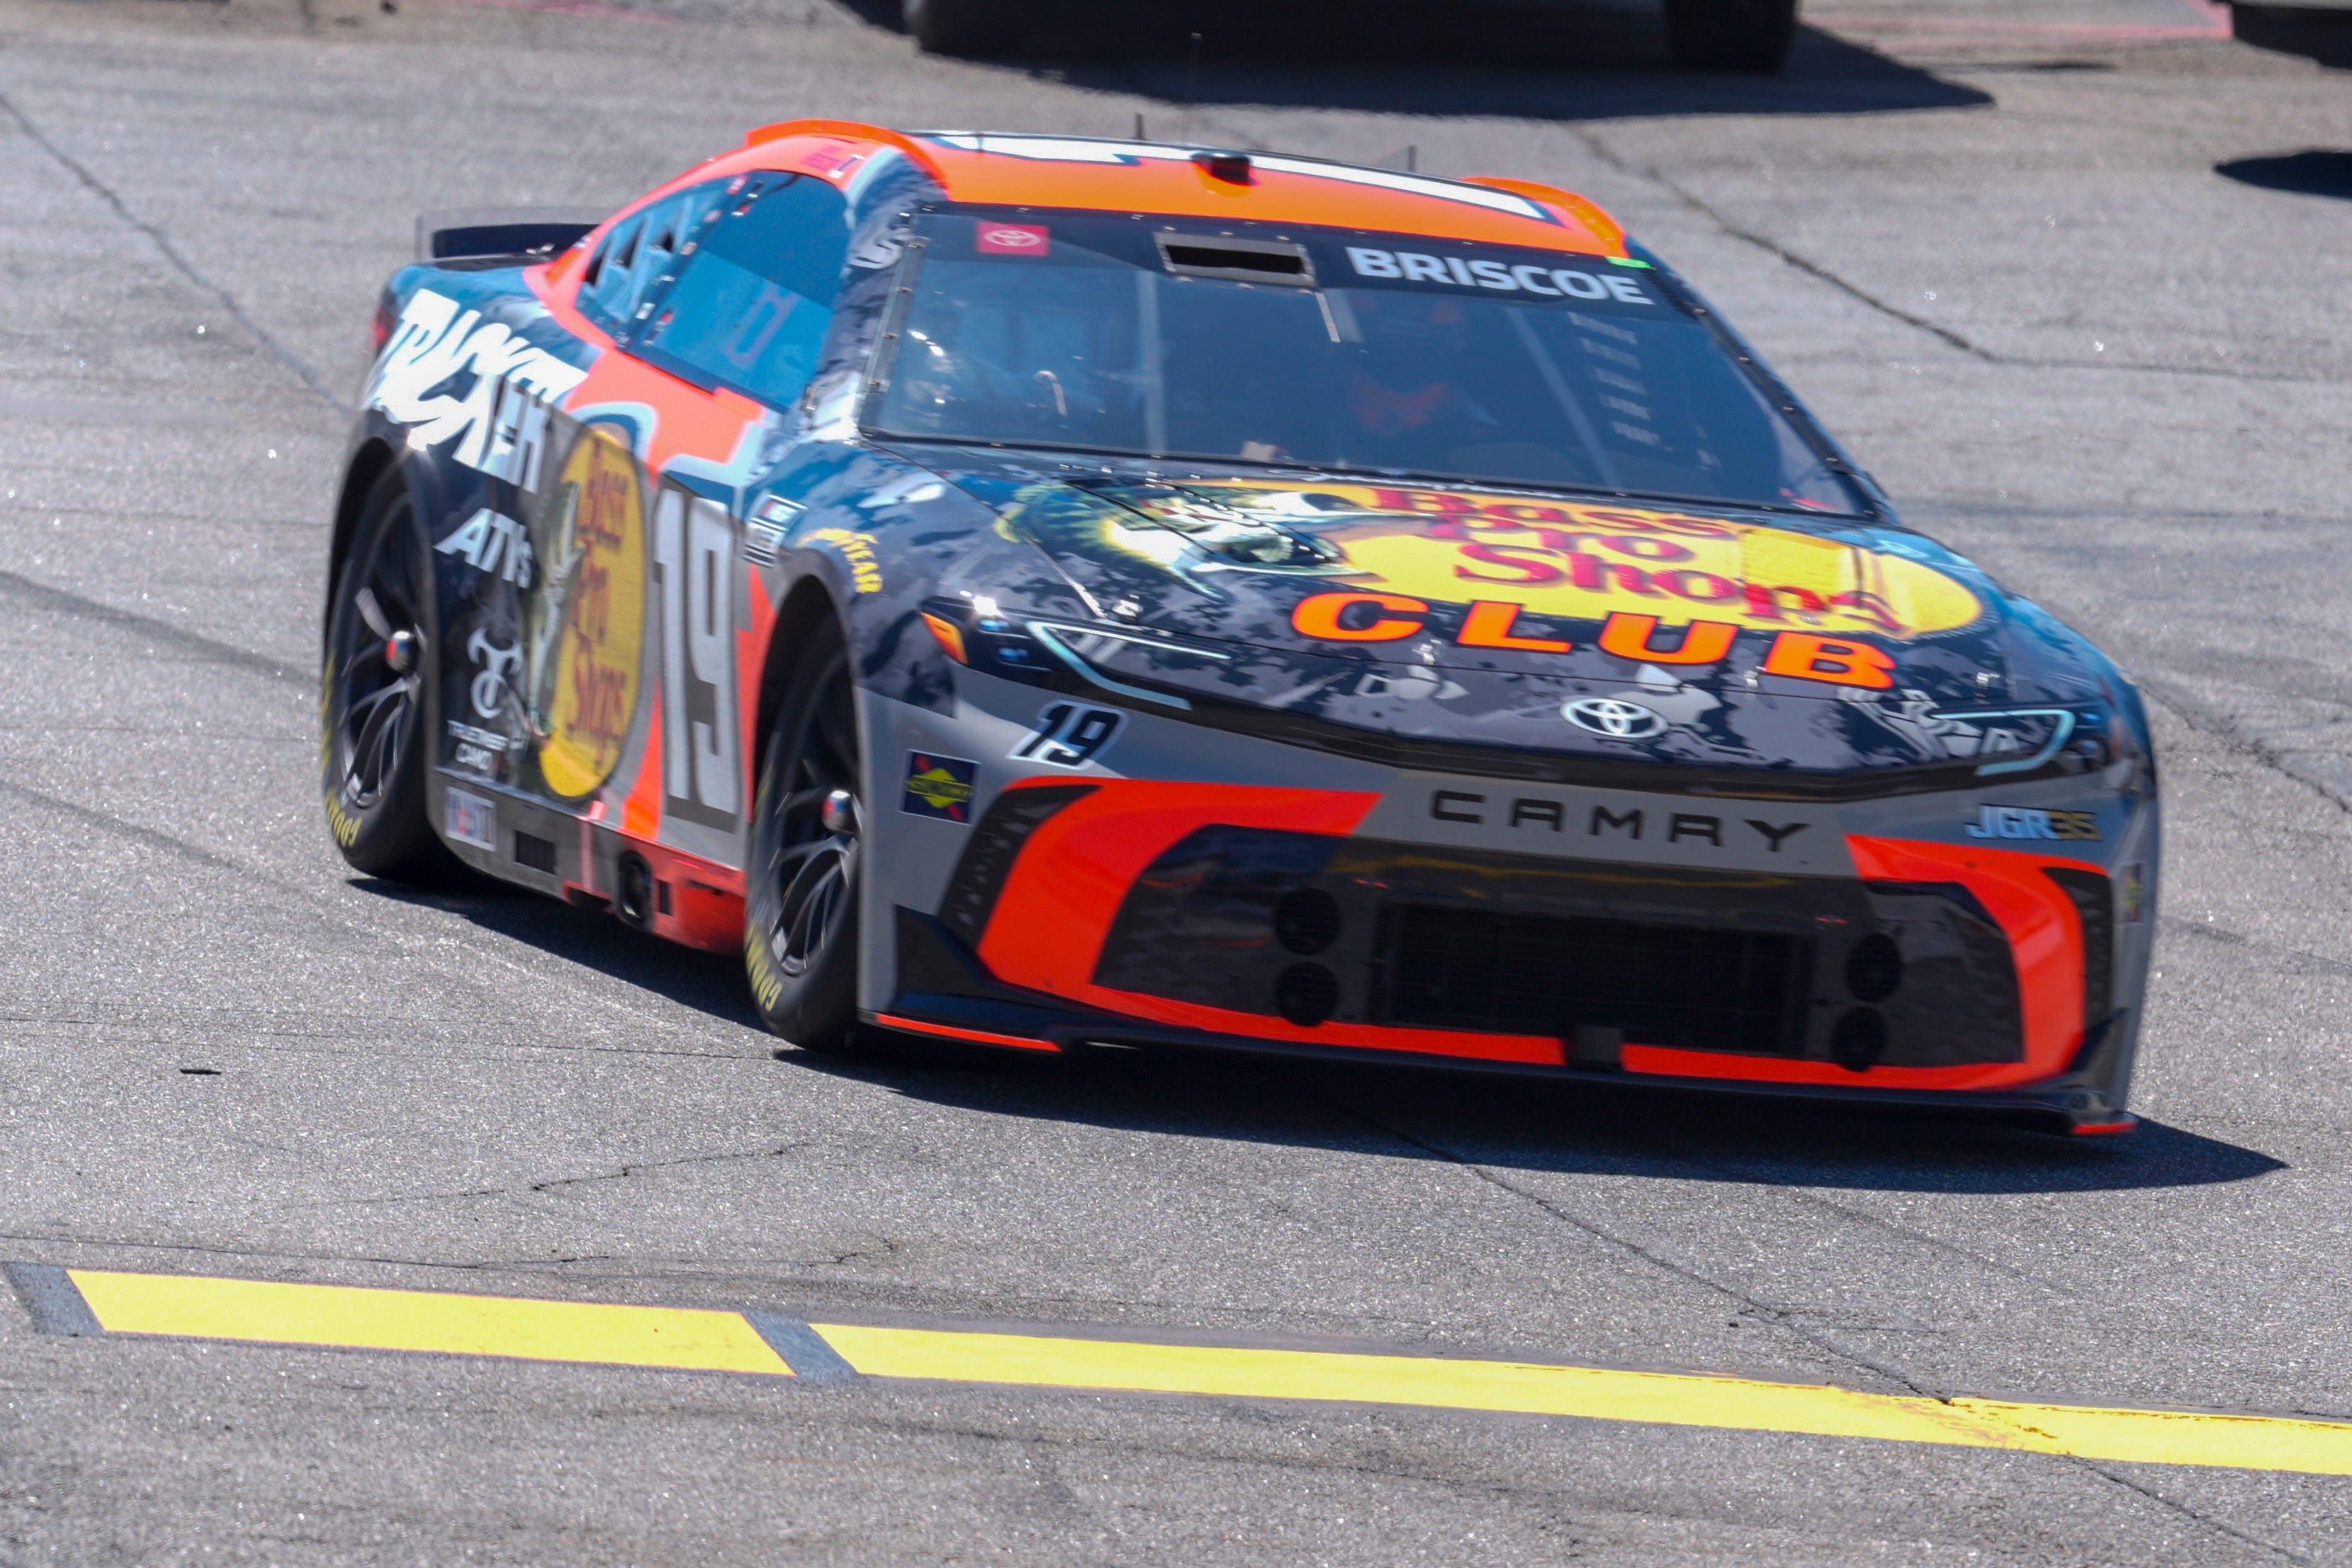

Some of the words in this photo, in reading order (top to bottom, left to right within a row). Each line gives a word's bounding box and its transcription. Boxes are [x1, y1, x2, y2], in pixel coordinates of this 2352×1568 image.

[1345, 246, 1656, 306] BRISCOE
[1367, 488, 1740, 541] Bass
[1427, 512, 1697, 563] Pro
[1454, 542, 1914, 638] Shops
[651, 487, 740, 816] 19
[1292, 591, 1896, 689] CLUB
[1006, 699, 1129, 771] 19
[1430, 789, 1813, 852] CAMRY
